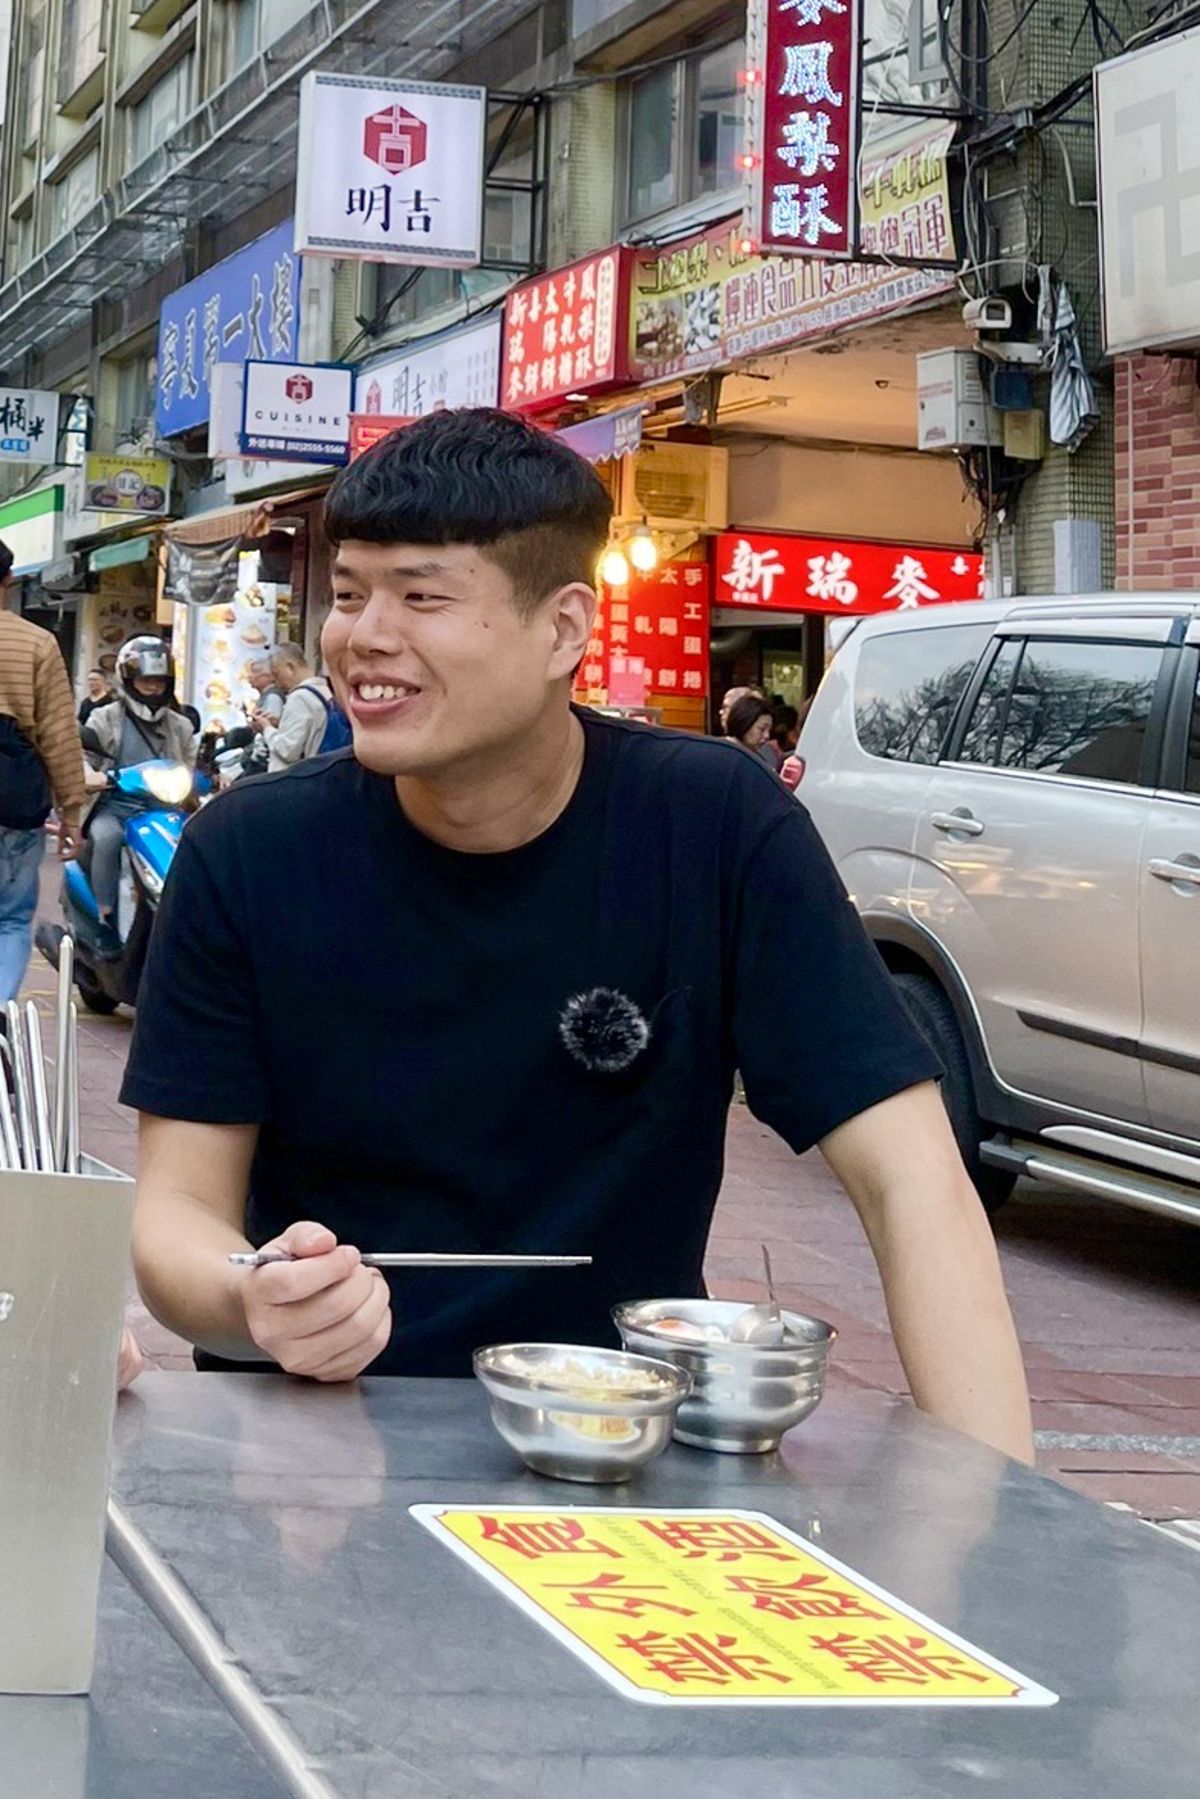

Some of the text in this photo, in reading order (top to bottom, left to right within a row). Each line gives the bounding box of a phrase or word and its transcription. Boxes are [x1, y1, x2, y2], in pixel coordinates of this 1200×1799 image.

[346, 184, 441, 232] 明吉
[255, 410, 341, 426] CUISINE
[721, 539, 941, 610] 新瑞麥
[477, 1514, 794, 1686] 禁外食
[638, 1518, 990, 1685] 禁飲酒
